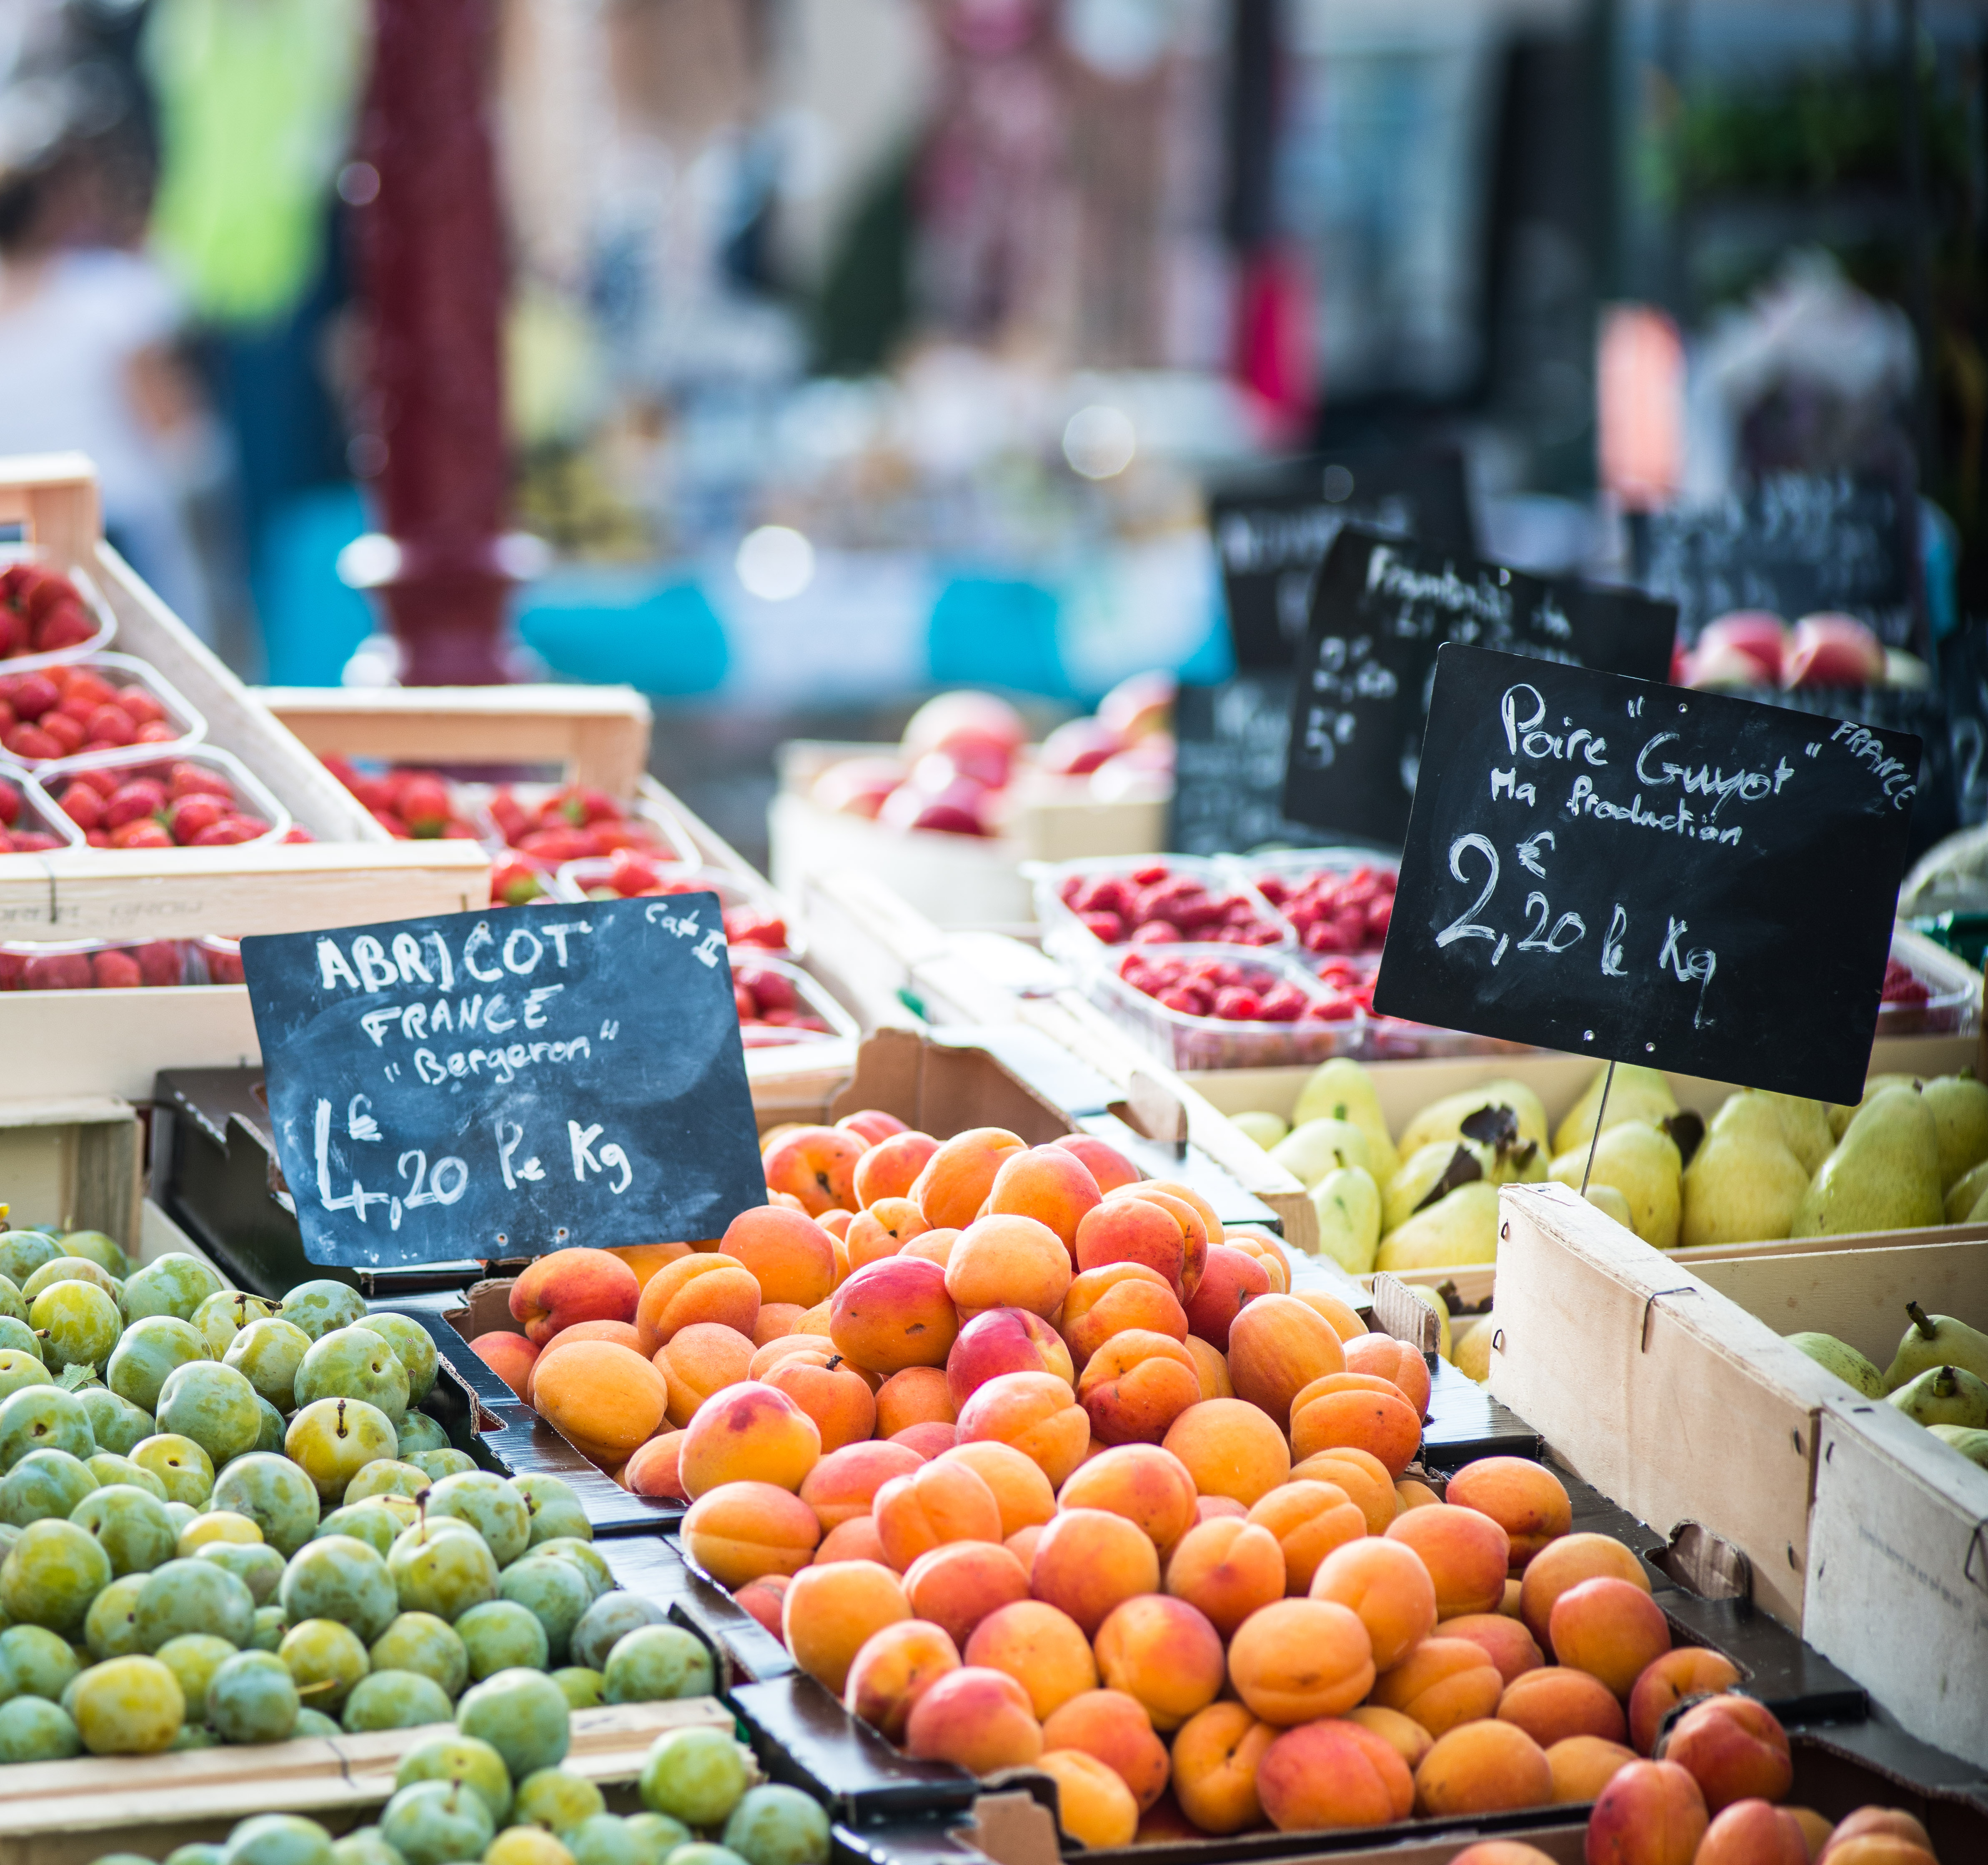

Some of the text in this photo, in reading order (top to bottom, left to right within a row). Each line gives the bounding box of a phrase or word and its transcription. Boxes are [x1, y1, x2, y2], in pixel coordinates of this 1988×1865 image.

[1502, 683, 1608, 766] Poire
[1830, 721, 1917, 810] FRANCE
[1566, 775, 1743, 847] Production
[315, 919, 594, 993] ABRICOT
[1658, 914, 1717, 1029] Kg
[361, 983, 565, 1048] FRANCE
[567, 1119, 633, 1195] Kg
